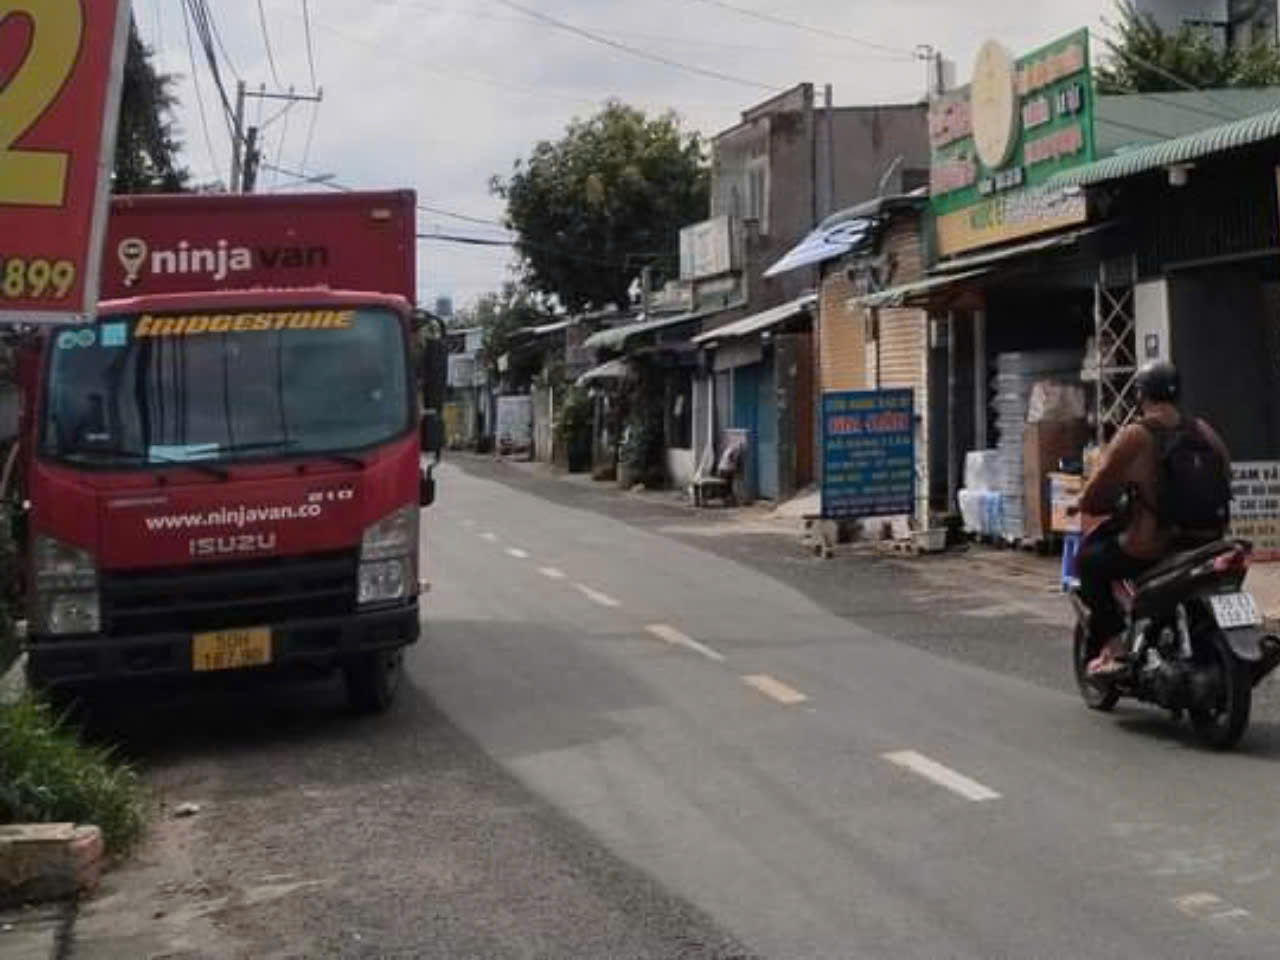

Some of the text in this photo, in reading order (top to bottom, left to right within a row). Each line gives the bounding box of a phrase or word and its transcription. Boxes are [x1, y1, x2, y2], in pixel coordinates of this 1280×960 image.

[151, 240, 328, 280] ninja van
[4, 258, 76, 297] 899
[145, 504, 322, 529] www.ninjavan.co
[189, 534, 276, 555] ISUZU
